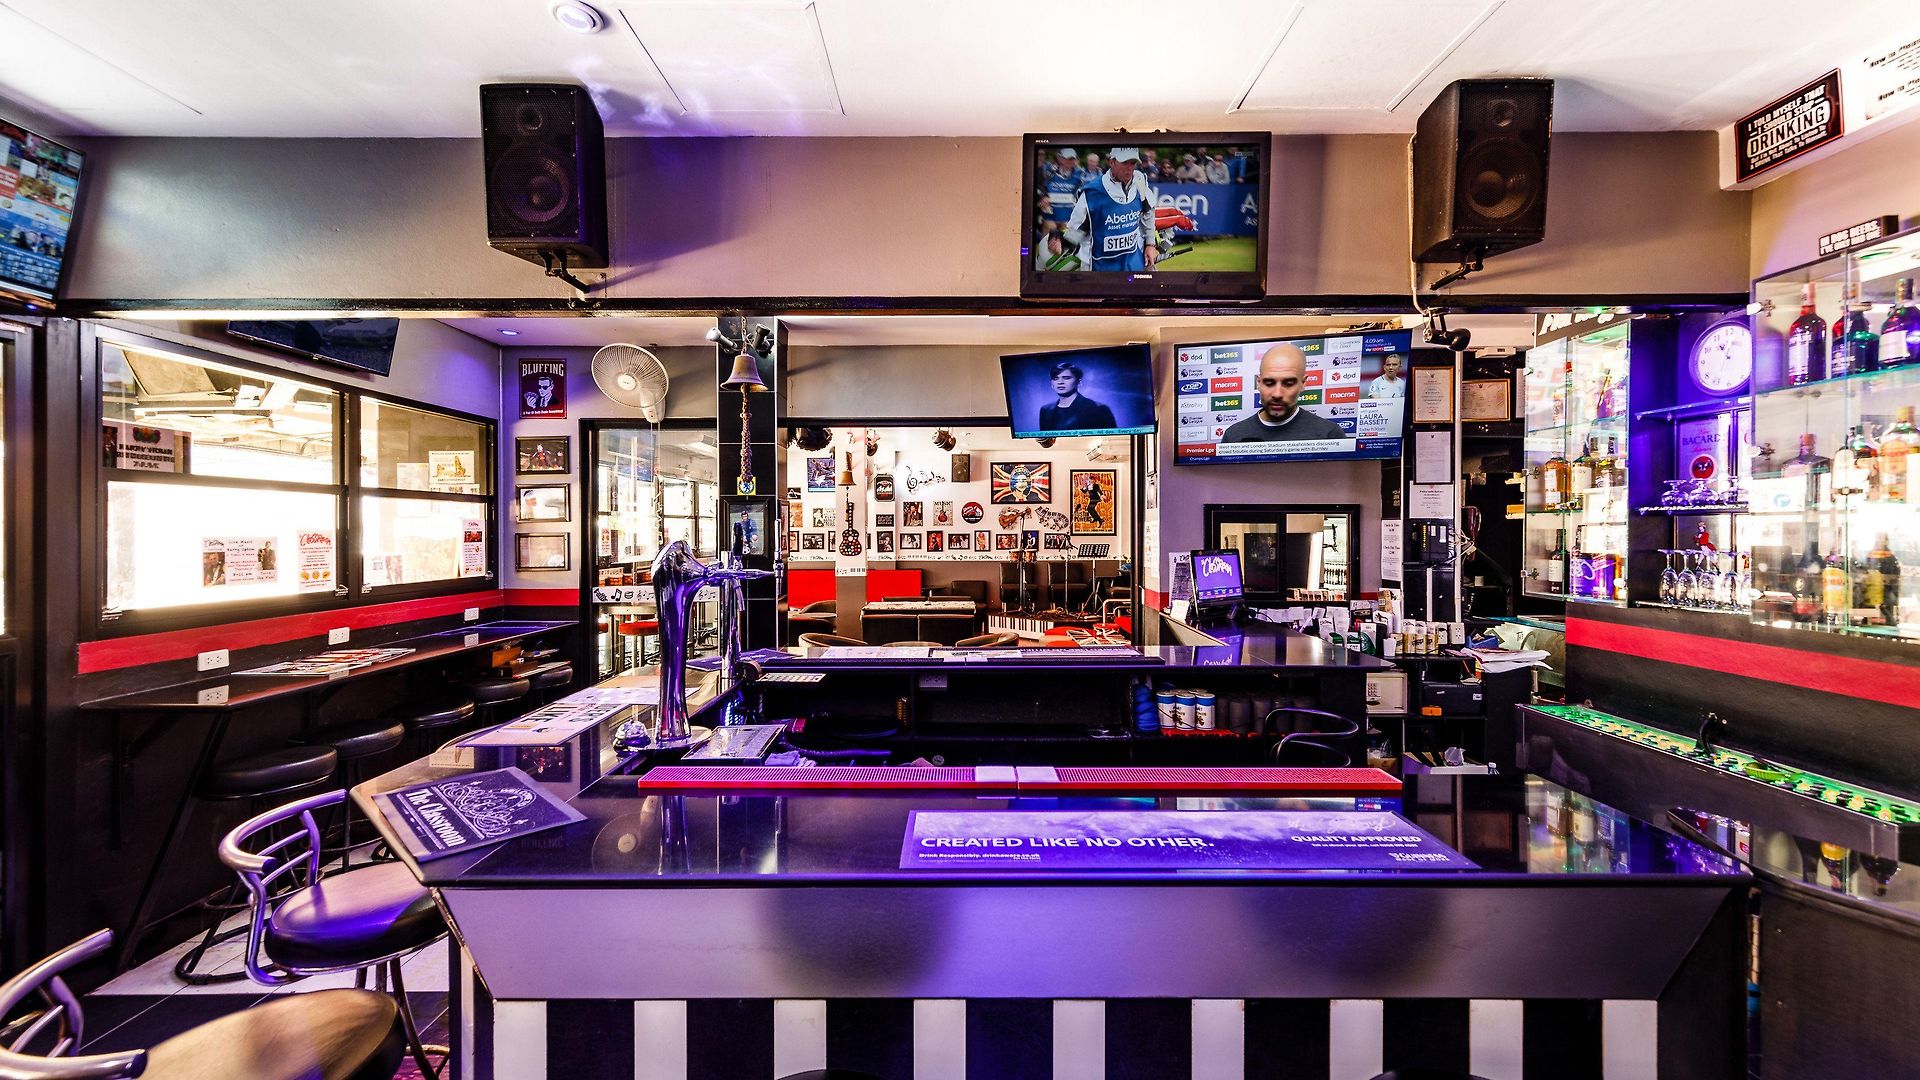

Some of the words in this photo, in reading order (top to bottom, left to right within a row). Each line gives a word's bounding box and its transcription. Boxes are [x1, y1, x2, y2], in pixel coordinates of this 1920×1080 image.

[1753, 113, 1772, 128] TOLD
[1772, 97, 1803, 118] MYSELF
[1750, 106, 1824, 156] DRINKING
[1104, 209, 1141, 226] Aberdee
[1214, 351, 1239, 359] bet365
[522, 363, 564, 377] BLUFFING
[1343, 372, 1356, 380] dpd
[1214, 399, 1239, 407] bet365
[1682, 433, 1722, 446] BACARD
[405, 787, 431, 806] The
[419, 800, 467, 848] Classroom
[920, 837, 1023, 848] CREATED
[1029, 837, 1079, 848] LIKE
[1084, 837, 1122, 848] NO
[1127, 837, 1215, 848] OTHER.
[1290, 835, 1348, 843] QUALITY
[1349, 835, 1423, 843] APPROVED
